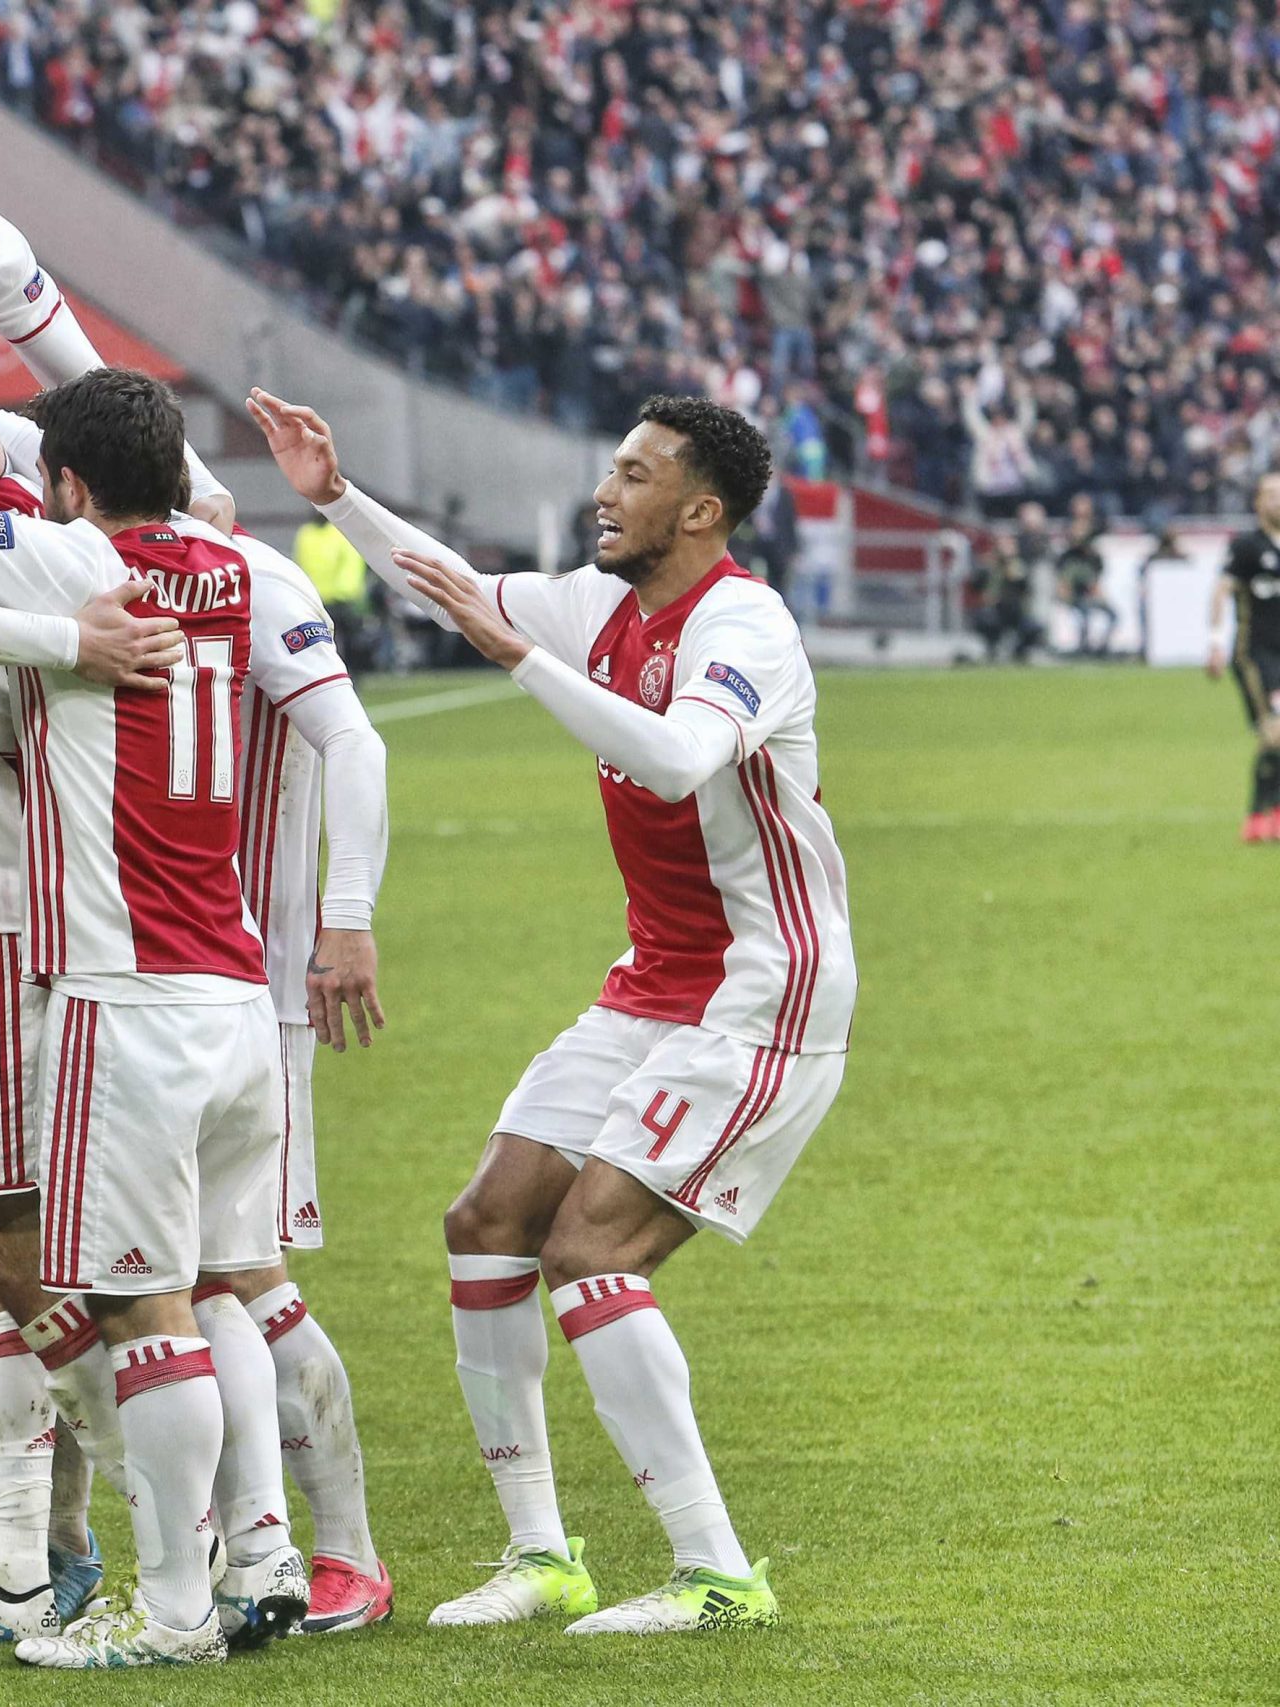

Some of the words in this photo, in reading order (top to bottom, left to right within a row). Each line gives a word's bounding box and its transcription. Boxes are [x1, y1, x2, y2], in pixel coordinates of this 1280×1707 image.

[727, 673, 759, 712] RESPECT
[160, 635, 235, 803] 11
[639, 1087, 695, 1165] 4
[714, 1196, 738, 1215] adidas
[110, 1264, 153, 1275] adidas
[280, 1434, 313, 1450] AX
[633, 1468, 655, 1488] AX
